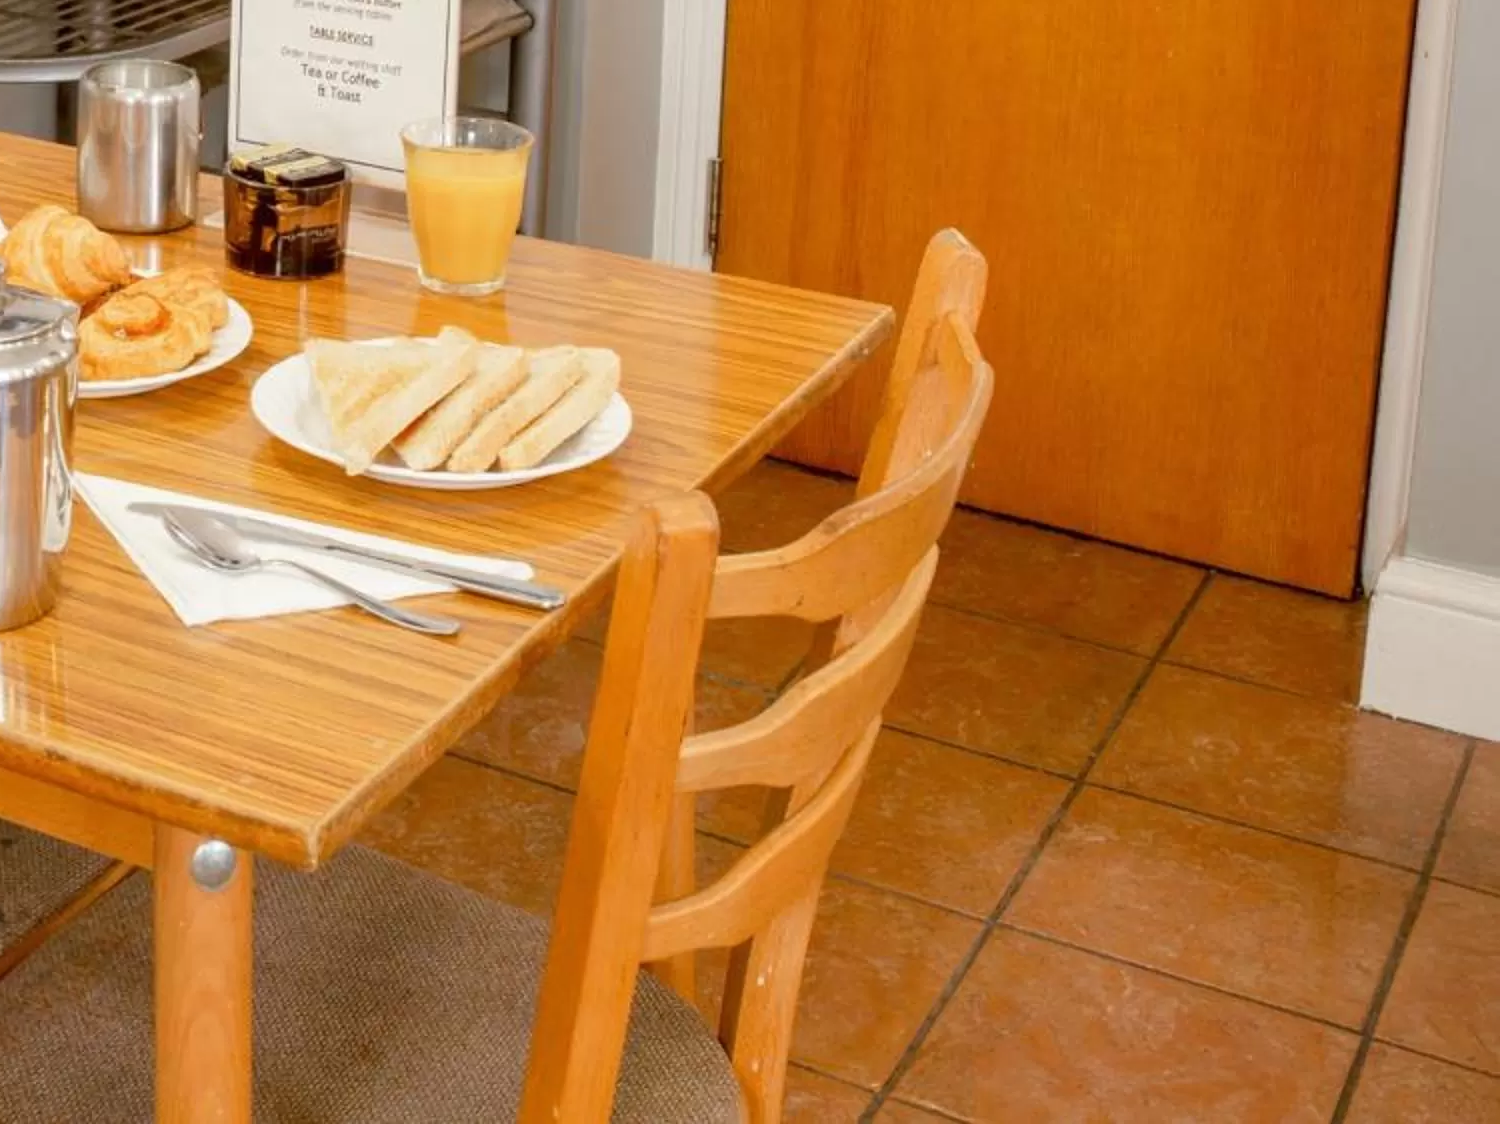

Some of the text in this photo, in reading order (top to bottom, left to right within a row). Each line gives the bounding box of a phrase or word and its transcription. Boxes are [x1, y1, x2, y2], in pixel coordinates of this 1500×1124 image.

[309, 25, 373, 47] TABLE SERVICE
[300, 63, 381, 89] Tea or Coffee
[330, 85, 361, 103] Toast
